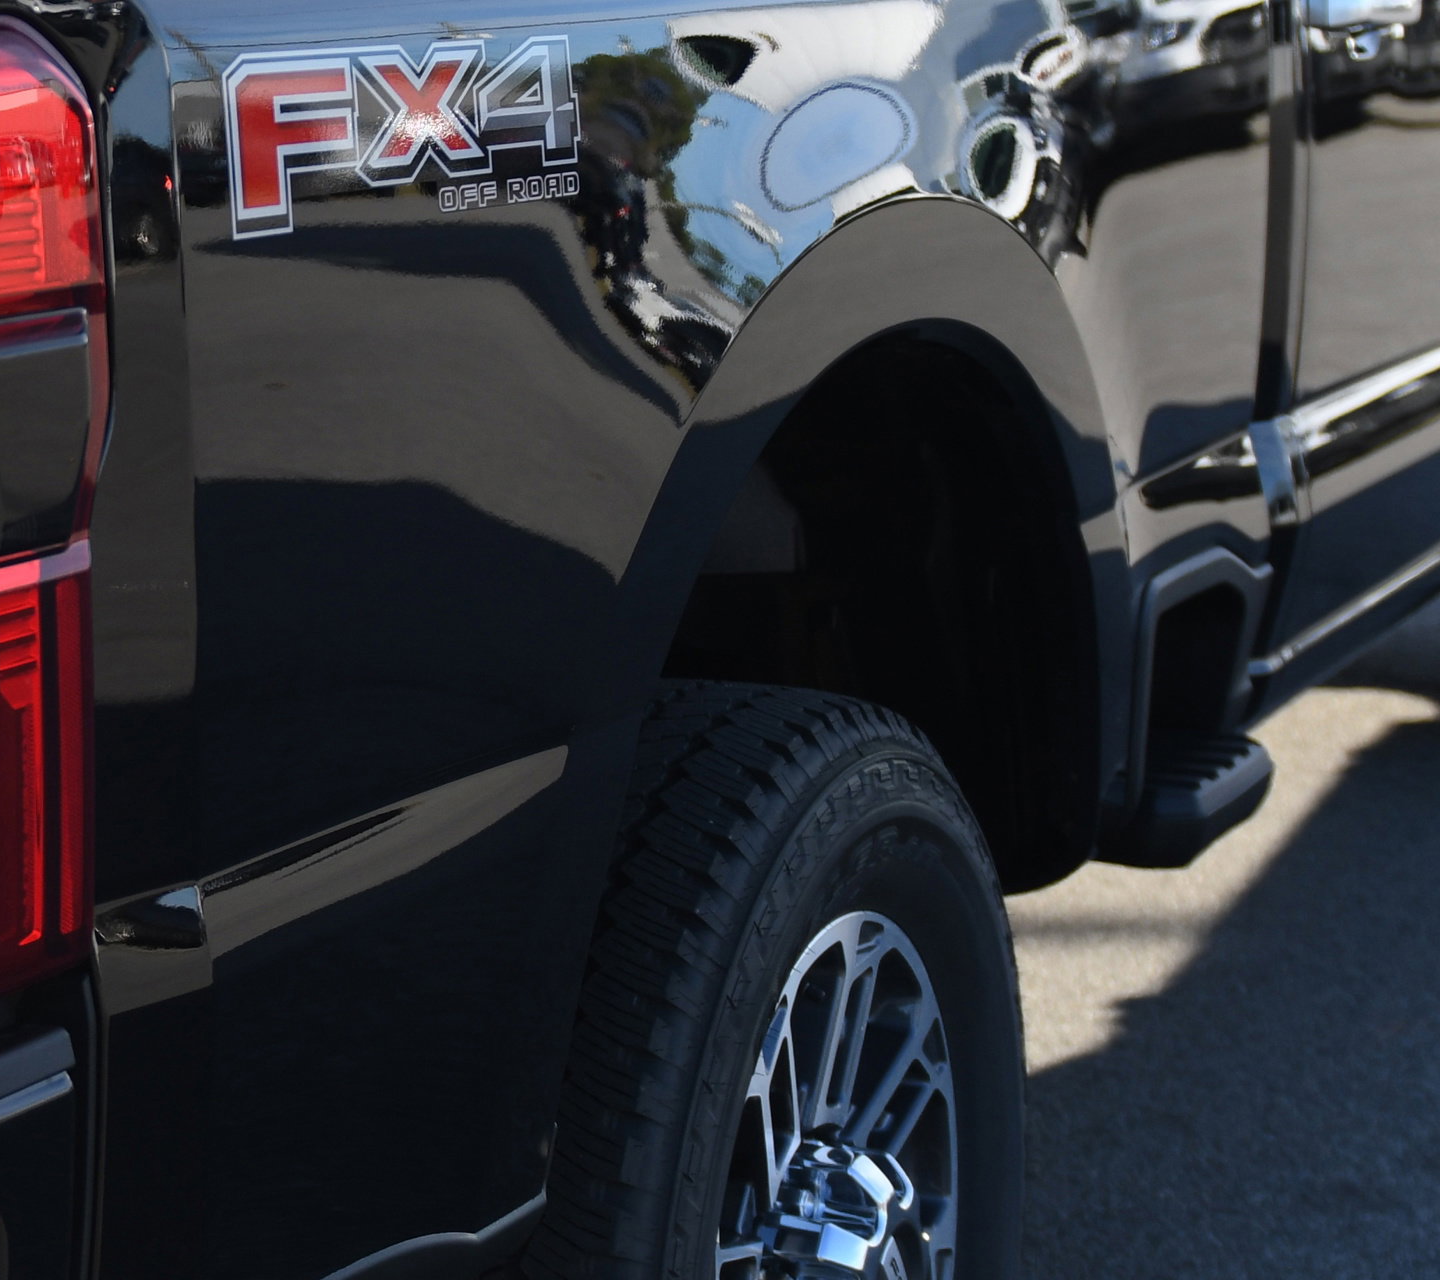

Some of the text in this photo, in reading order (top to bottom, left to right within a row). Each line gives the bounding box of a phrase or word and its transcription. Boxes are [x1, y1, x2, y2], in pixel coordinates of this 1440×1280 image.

[222, 34, 581, 240] FX4
[438, 171, 580, 212] OFF ROAD
